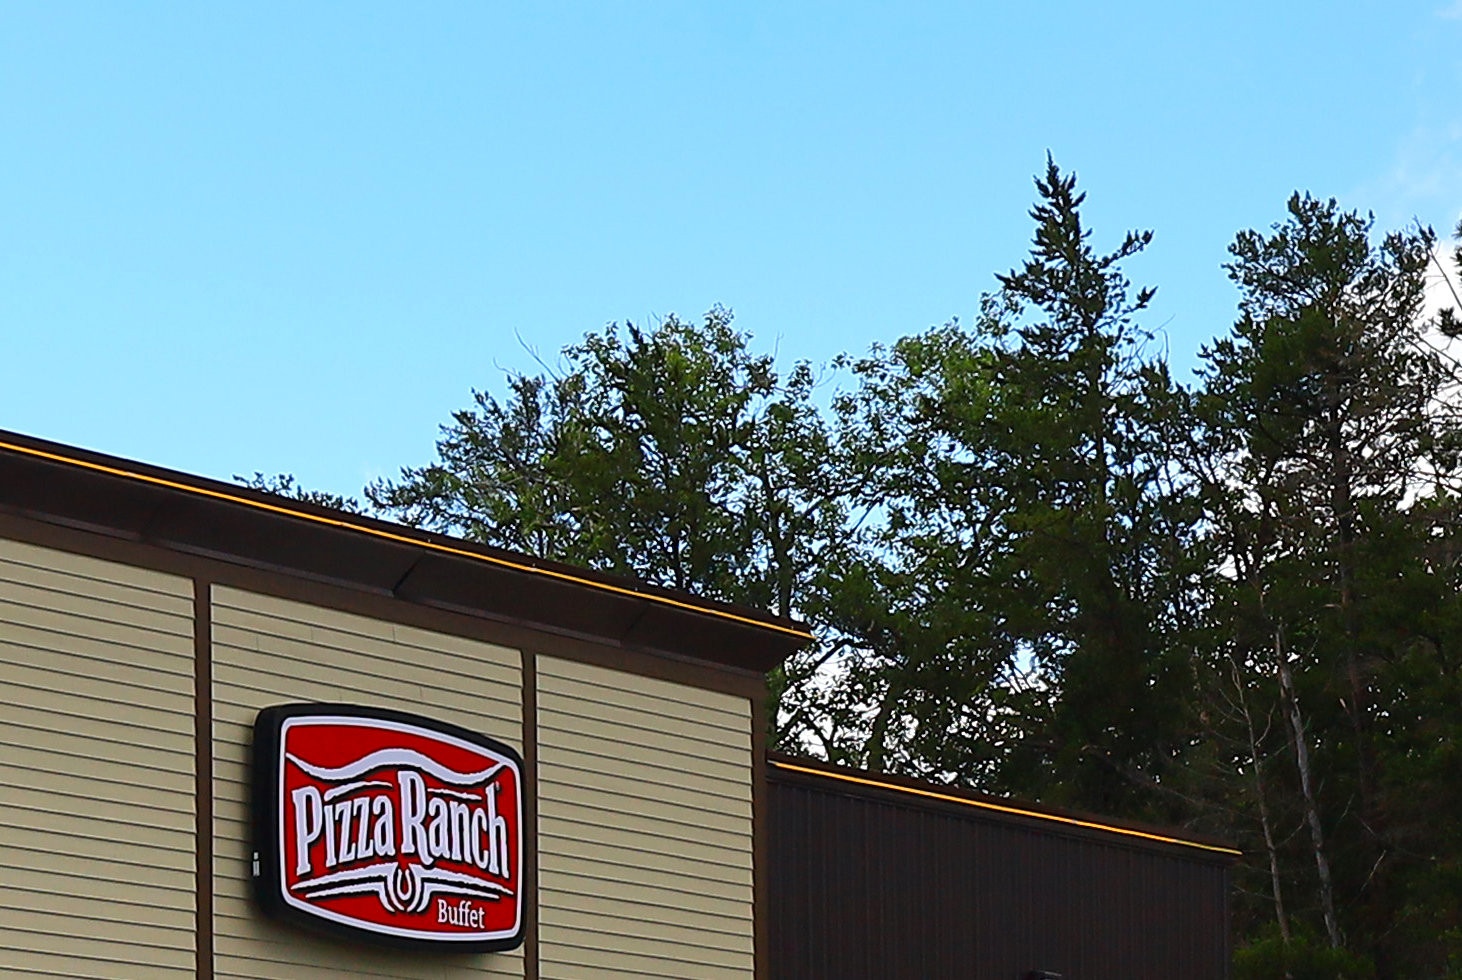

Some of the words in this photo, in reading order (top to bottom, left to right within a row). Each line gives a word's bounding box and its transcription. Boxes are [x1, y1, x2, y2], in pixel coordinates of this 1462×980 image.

[291, 785, 396, 876] Pizza
[397, 770, 510, 879] Ranch
[437, 899, 486, 929] Buffet
